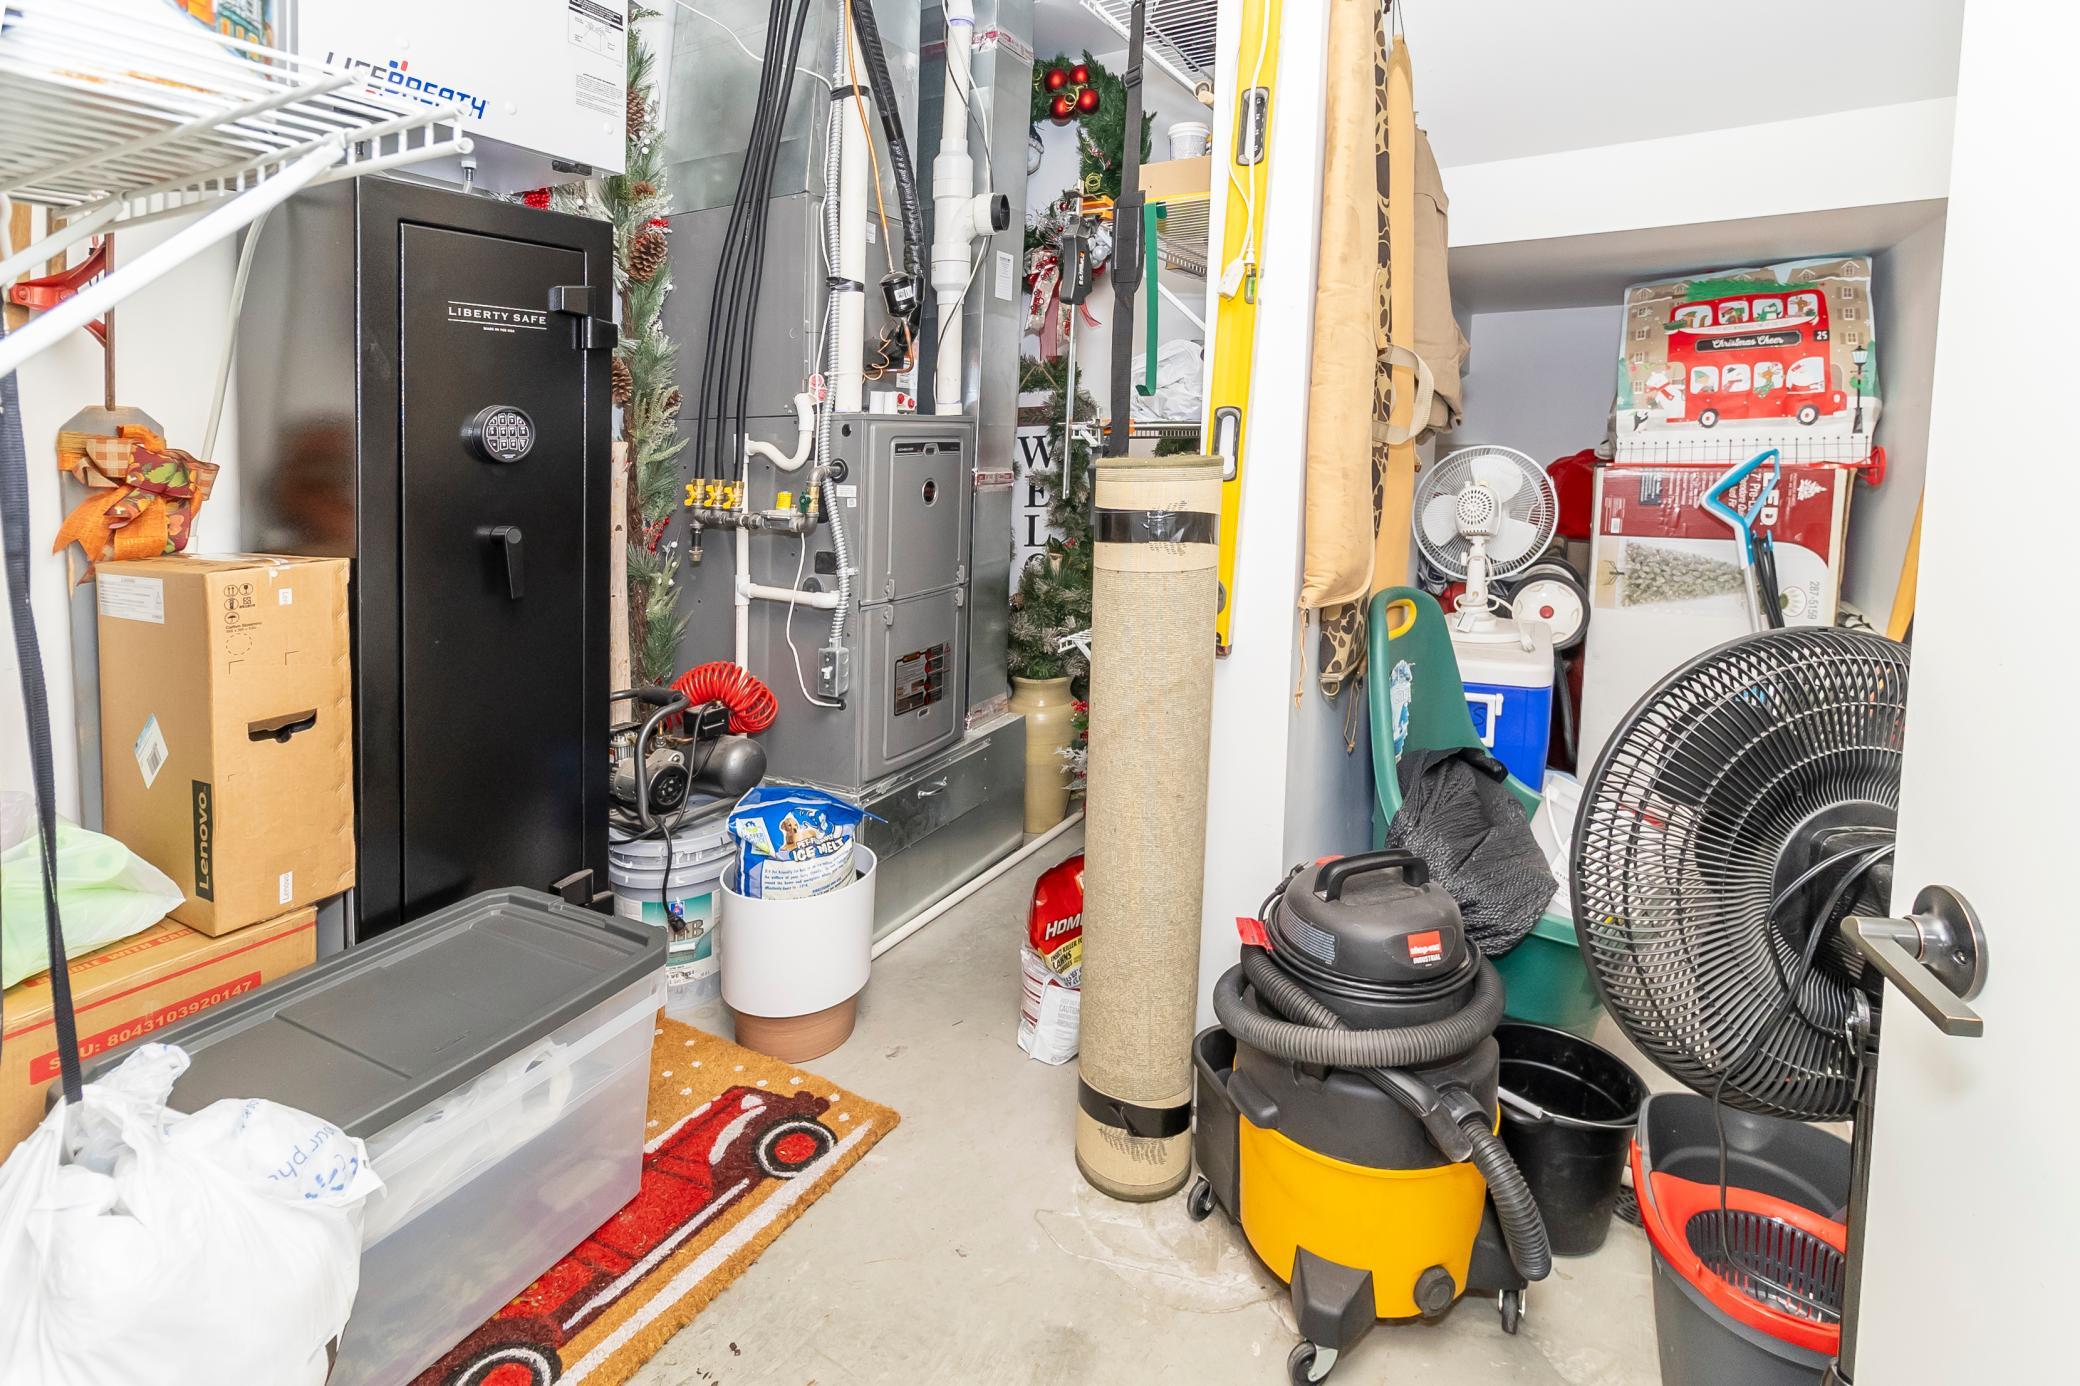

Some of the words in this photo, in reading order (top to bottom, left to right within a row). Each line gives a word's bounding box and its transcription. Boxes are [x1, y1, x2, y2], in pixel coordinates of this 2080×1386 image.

[448, 307, 509, 321] LIBERTY
[513, 314, 547, 325] SAFE
[1712, 338, 1756, 349] Christmas
[1757, 335, 1785, 345] Cheer
[1816, 331, 1828, 341] 25
[199, 791, 209, 890] Lenovo
[792, 846, 816, 862] ICE
[1044, 912, 1084, 941] HOM
[49, 1042, 100, 1071] SU:
[106, 980, 253, 1047] 8043103920147
